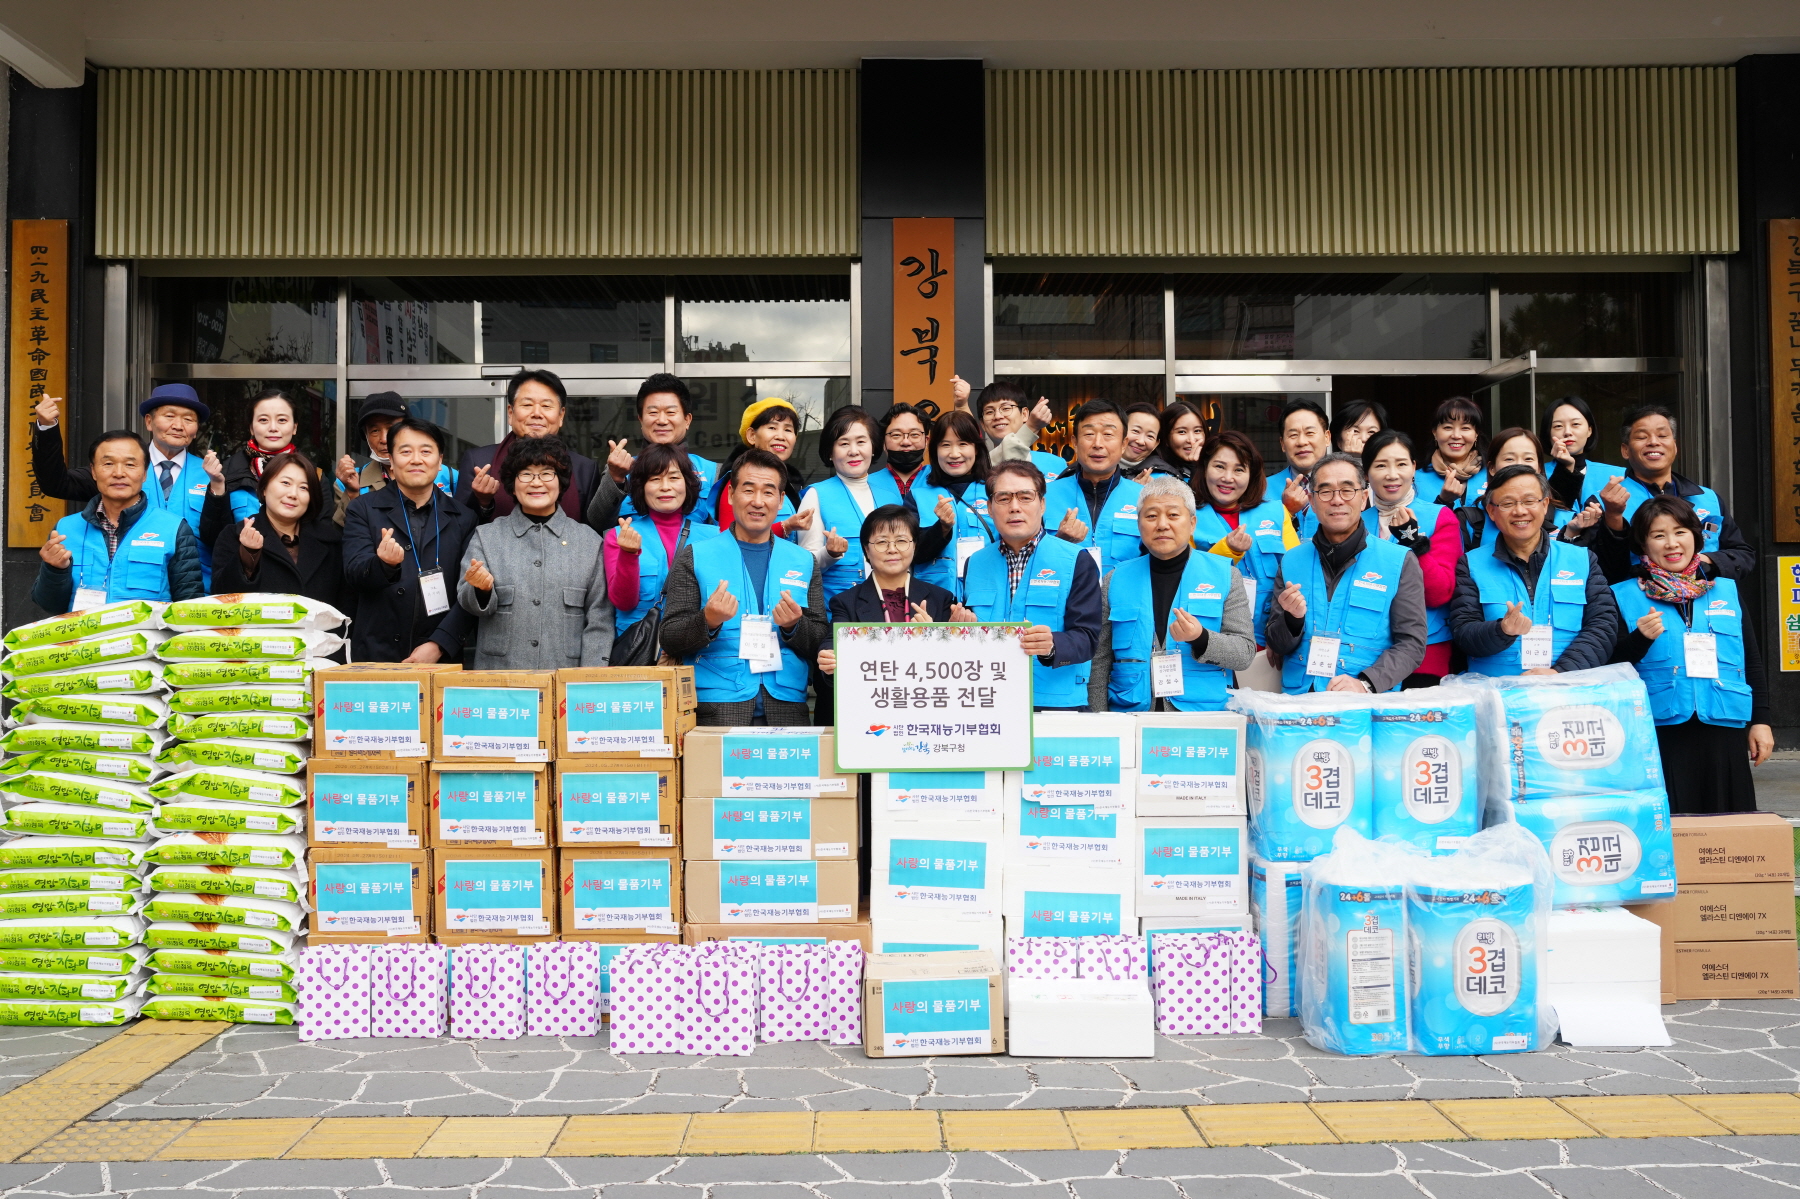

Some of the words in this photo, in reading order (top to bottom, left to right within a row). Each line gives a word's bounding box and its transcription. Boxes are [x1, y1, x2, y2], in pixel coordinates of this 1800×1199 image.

[210, 641, 233, 652] 영암
[860, 660, 899, 681] 연탄
[905, 660, 983, 682] 4,500장
[990, 661, 1007, 681] 및
[219, 694, 243, 706] 영암
[870, 686, 950, 709] 생활용품
[957, 686, 997, 708] 전달
[333, 701, 365, 713] 사랑의
[368, 701, 412, 713] 물품기부
[574, 702, 607, 714] 사랑의
[610, 702, 655, 713] 물품기부
[451, 707, 483, 719] 사랑의
[486, 707, 531, 720] 물품기부
[1409, 710, 1443, 723] 24+6롤
[208, 721, 232, 732] 영암
[907, 723, 1001, 736] 한국재능기부협회
[357, 735, 412, 744] 한국재능기부협회
[599, 735, 655, 745] 한국재능기부협회
[1562, 721, 1588, 755] 3겹
[1586, 718, 1605, 757] 데코
[474, 741, 530, 751] 한국재능기부협회
[933, 743, 965, 752] 강북구청
[729, 747, 763, 760] 사랑의
[766, 747, 811, 760] 물품기부
[1148, 746, 1182, 758] 사랑의
[1185, 746, 1229, 759] 물품기부
[1313, 752, 1331, 763] 리빙
[1422, 747, 1439, 759] 리빙
[1068, 755, 1113, 767] 물품기부
[1304, 765, 1341, 791] 3겹
[1415, 761, 1449, 786] 3겹
[754, 782, 811, 791] 한국재능기부협회
[1172, 780, 1228, 789] 한국재능기부협회
[322, 792, 353, 805] 사랑의
[356, 793, 400, 806] 물품기부
[447, 790, 479, 803] 사랑의
[482, 790, 526, 803] 물품기부
[570, 792, 602, 803] 사랑의
[606, 791, 650, 803] 물품기부
[920, 794, 977, 803] 한국재능기부협회
[1055, 789, 1112, 798] 한국재능기부협회
[1413, 786, 1449, 804] 데코
[1303, 791, 1341, 810] 데코
[721, 810, 755, 823] 사랑의
[758, 810, 803, 823] 물품기부
[1027, 807, 1061, 820] 사랑의
[345, 827, 400, 836] 한국재능기부협회
[471, 824, 526, 833] 한국재능기부협회
[594, 826, 651, 835] 한국재능기부협회
[746, 844, 803, 853] 한국재능기부협회
[1051, 842, 1108, 851] 한국재능기부협회
[1152, 846, 1184, 858] 사랑의
[1188, 846, 1232, 857] 물품기부
[1698, 847, 1726, 855] 여에스더
[197, 850, 222, 862] 영암
[1576, 837, 1602, 872] 3겹
[1602, 834, 1621, 873] 데코
[38, 854, 63, 865] 영암
[897, 857, 930, 870] 사랑의
[933, 858, 978, 871] 물품기부
[1699, 856, 1726, 864] 엘라스틴
[1728, 855, 1754, 863] 디엔에이
[35, 879, 59, 889] 영암
[201, 880, 225, 891] 영암
[454, 879, 486, 892] 사랑의
[489, 879, 534, 892] 물품기부
[581, 878, 614, 891] 사랑의
[618, 878, 662, 890] 물품기부
[727, 875, 761, 886] 사랑의
[765, 875, 809, 886] 물품기부
[1175, 879, 1232, 889] 한국재능기부협회
[324, 882, 356, 895] 사랑의
[359, 882, 404, 895] 물품기부
[921, 892, 977, 901] 한국재능기부협회
[753, 908, 809, 916] 한국재능기부협회
[1031, 910, 1064, 922] 사랑의
[1068, 911, 1113, 923] 물품기부
[1700, 914, 1727, 922] 엘라스틴
[1729, 913, 1756, 921] 디엔에이
[349, 915, 405, 925] 한국재능기부협회
[479, 913, 534, 923] 한국재능기부협회
[606, 913, 662, 923] 한국재능기부협회
[1364, 915, 1378, 926] 3겹
[1363, 926, 1379, 934] 데코
[28, 932, 53, 943] 영암
[1477, 932, 1495, 945] 리빙
[32, 956, 56, 968] 영암
[1468, 946, 1506, 974] 3겹
[1701, 963, 1729, 971] 여에스더
[1731, 972, 1758, 980] 디엔에이
[25, 985, 49, 996] 영암
[199, 983, 224, 994] 영암
[1466, 975, 1506, 995] 데코
[892, 1000, 928, 1014] 사랑의
[932, 999, 981, 1013] 물품기부
[920, 1036, 982, 1046] 한국재능기부협회
